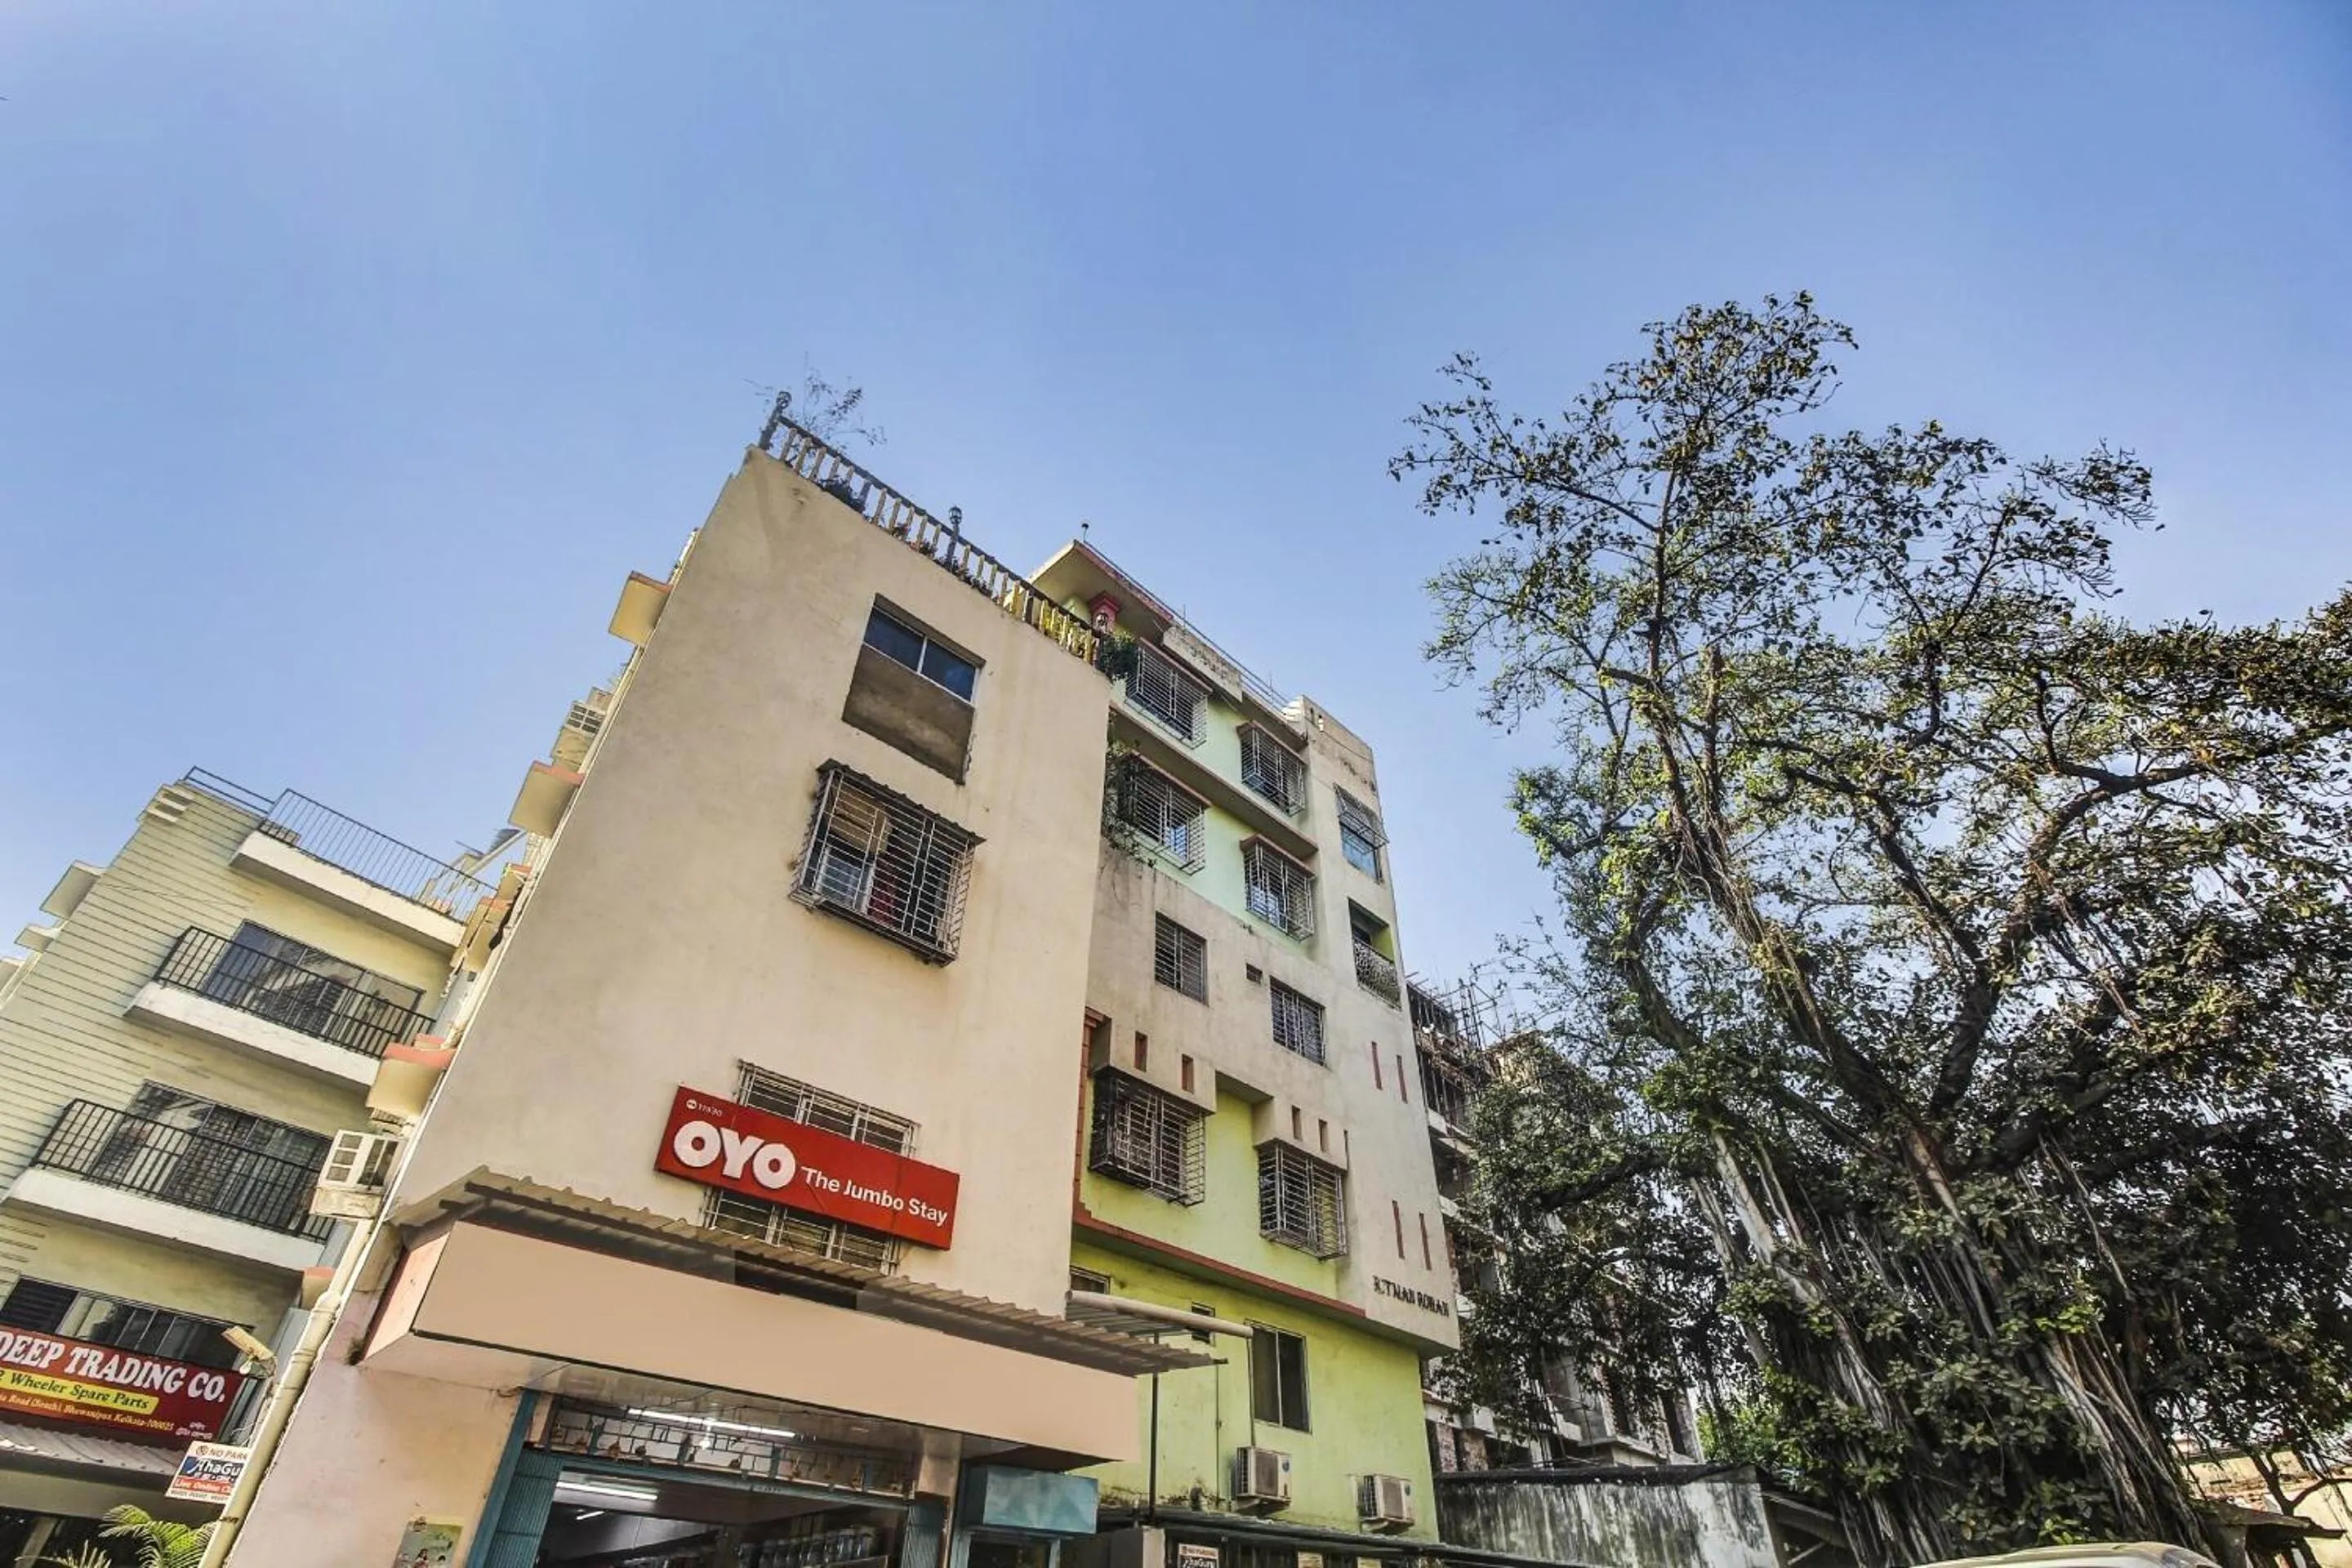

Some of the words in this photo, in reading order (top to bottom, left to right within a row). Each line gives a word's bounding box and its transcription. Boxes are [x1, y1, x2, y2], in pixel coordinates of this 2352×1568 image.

[674, 1120, 796, 1189] OYO
[800, 1165, 840, 1193] The
[843, 1179, 904, 1211] Jumbo
[908, 1197, 948, 1226] Stay
[11, 1372, 67, 1393] Wheeler
[70, 1384, 109, 1400] Spare
[113, 1392, 149, 1409] Parts
[64, 1347, 187, 1393] TRADING
[188, 1372, 225, 1402] CO.
